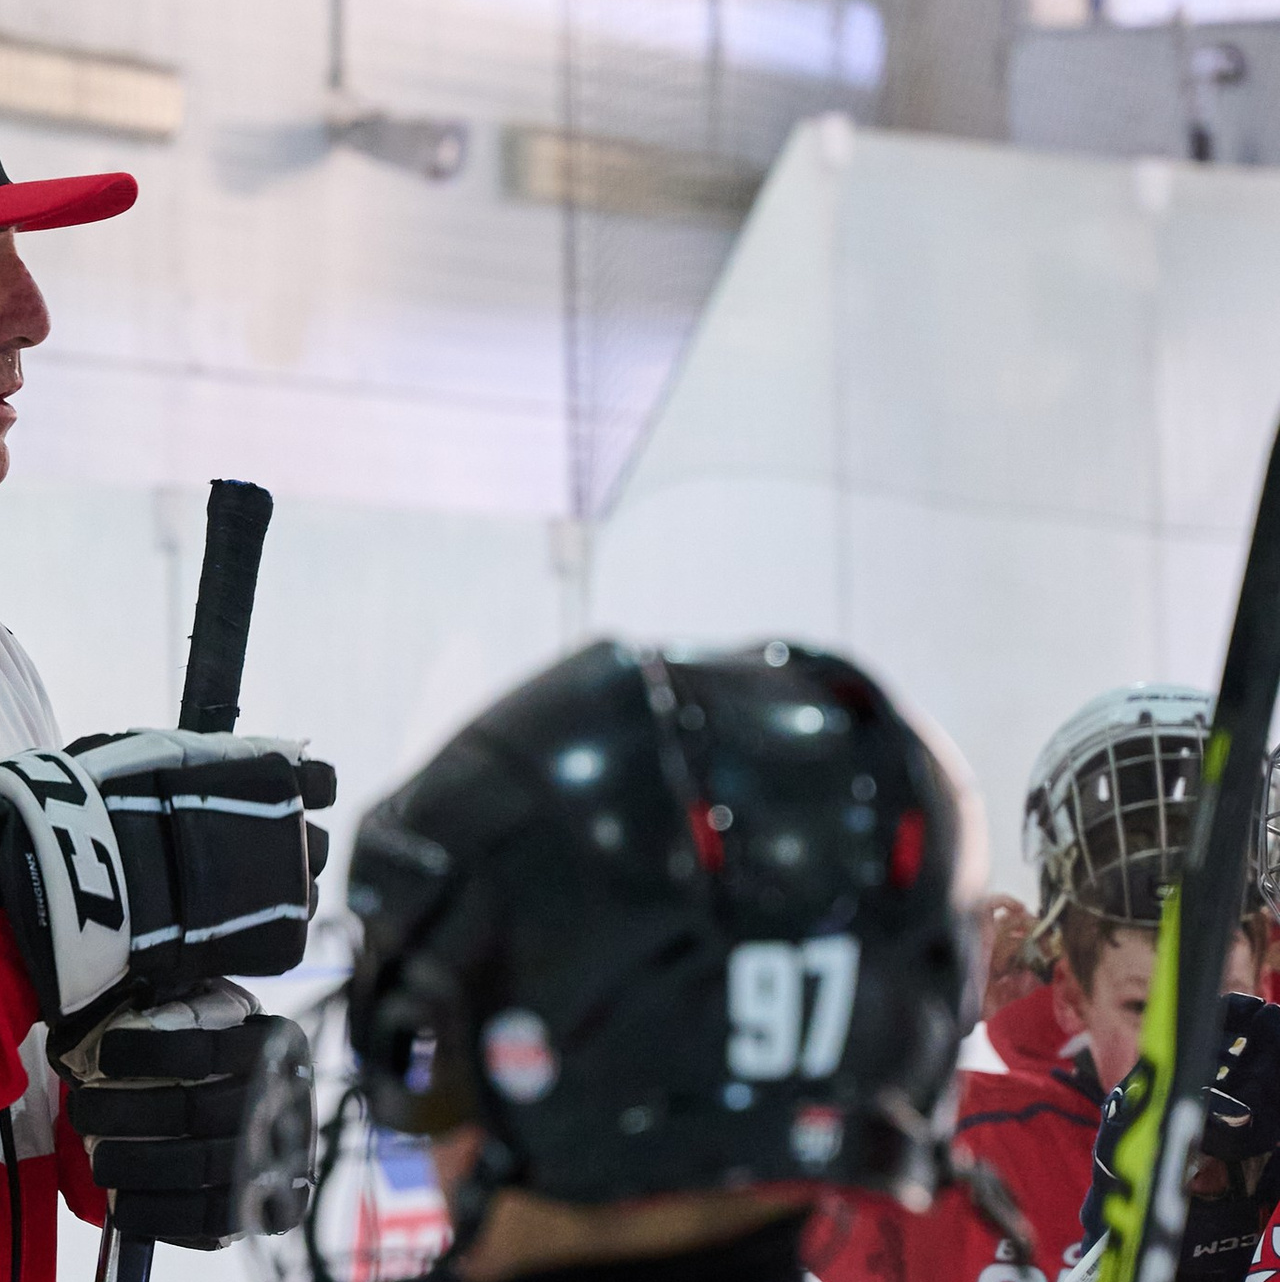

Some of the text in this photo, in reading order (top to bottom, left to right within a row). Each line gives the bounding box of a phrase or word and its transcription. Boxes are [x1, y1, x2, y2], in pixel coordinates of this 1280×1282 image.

[24, 852, 48, 928] PENGUINS
[727, 933, 862, 1081] 97
[1192, 1232, 1257, 1258] CCM
